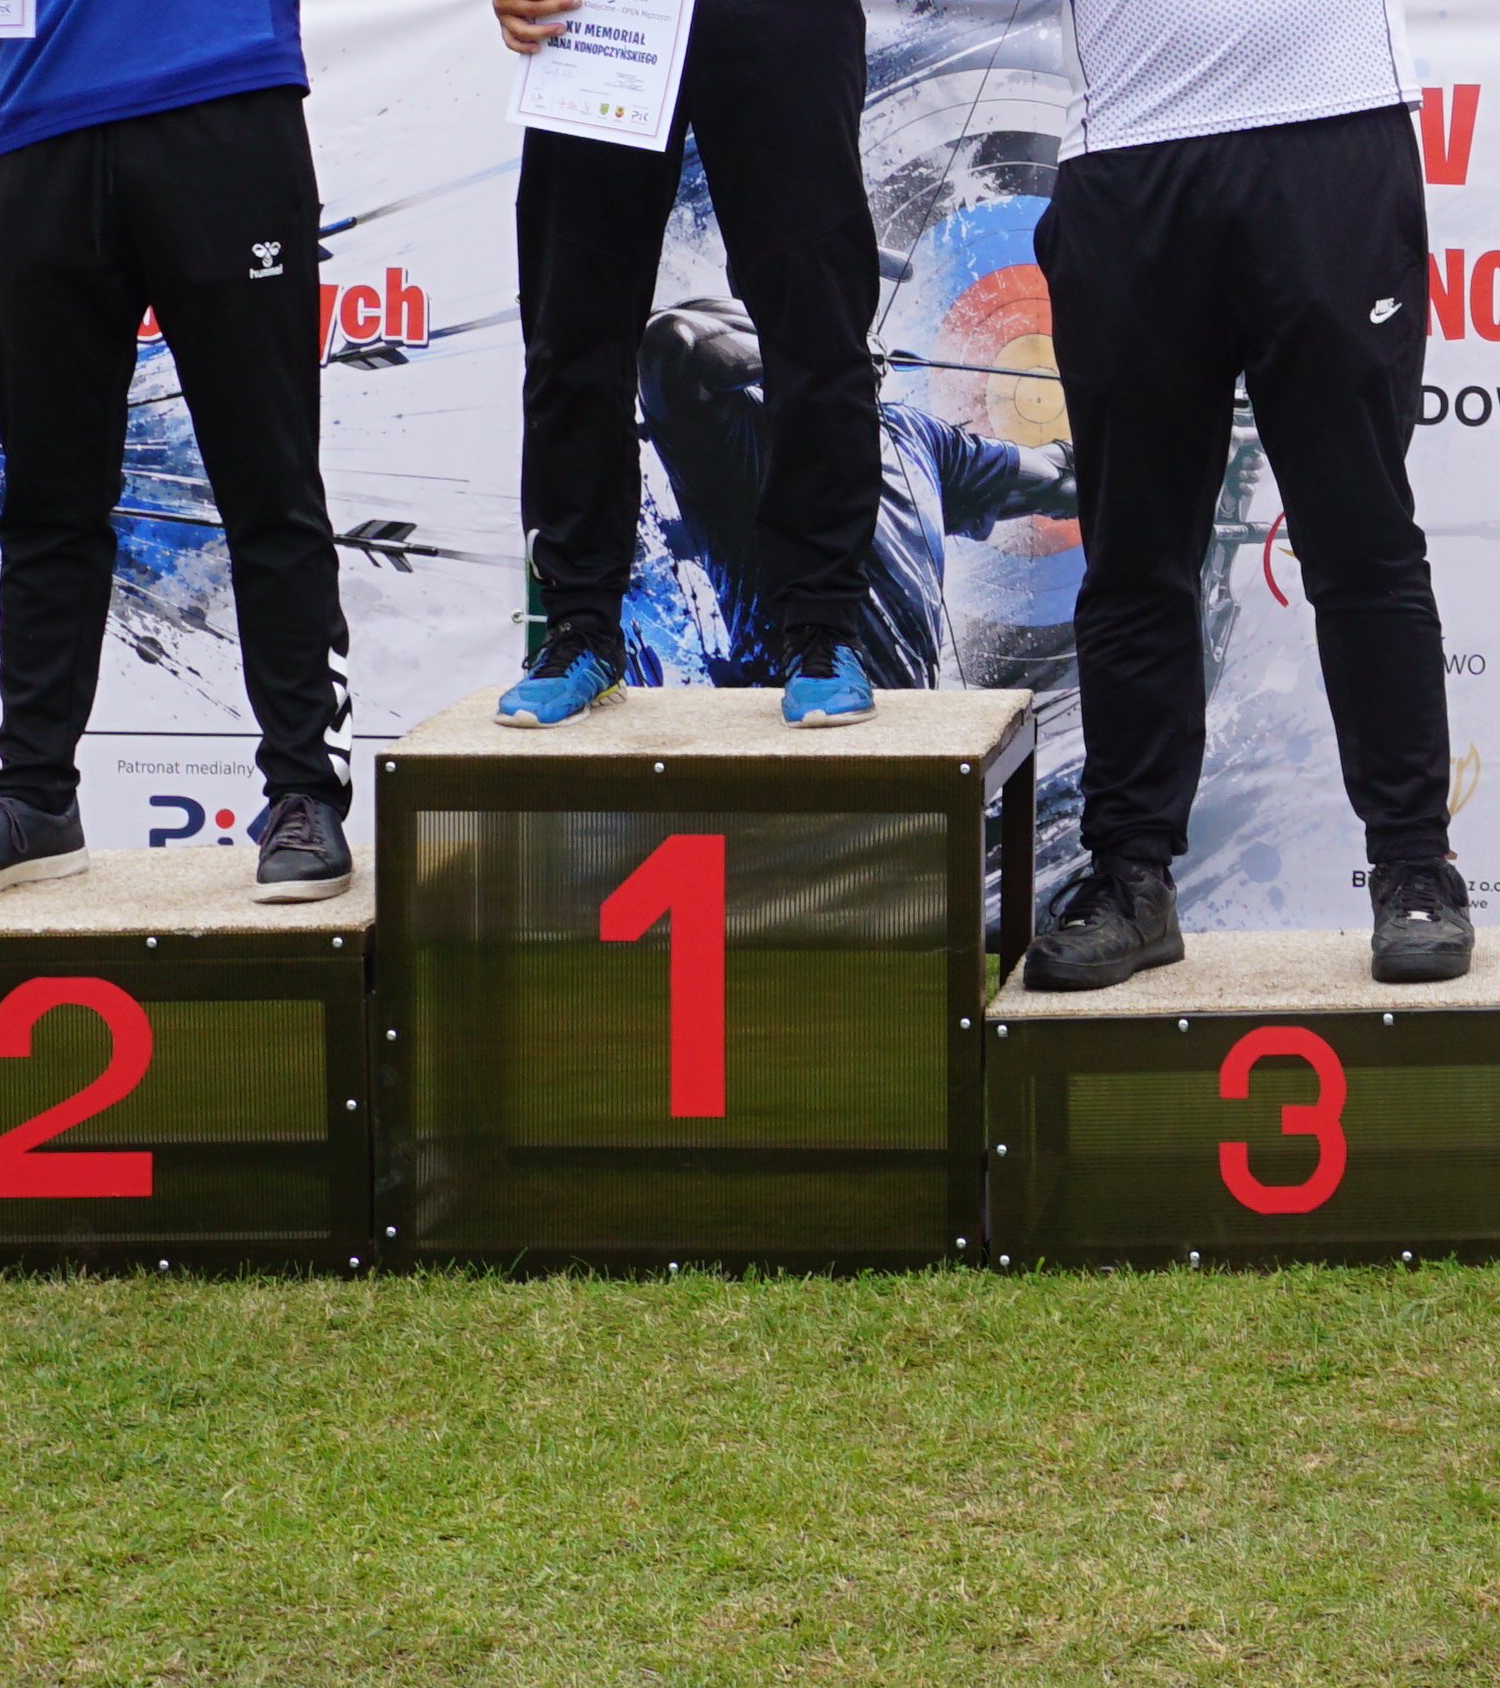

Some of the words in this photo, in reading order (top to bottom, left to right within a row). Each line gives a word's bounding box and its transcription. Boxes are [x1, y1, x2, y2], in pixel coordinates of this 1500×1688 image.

[565, 20, 582, 35] XV
[585, 24, 646, 46] MEMORIAŁ
[547, 36, 572, 50] JANA
[573, 40, 658, 66] KONOPCZYŃSKIEGO
[249, 262, 284, 280] hummel
[117, 759, 180, 776] Patronat
[185, 760, 255, 778] medialny
[599, 833, 726, 1119] 1
[1218, 1024, 1348, 1215] 3
